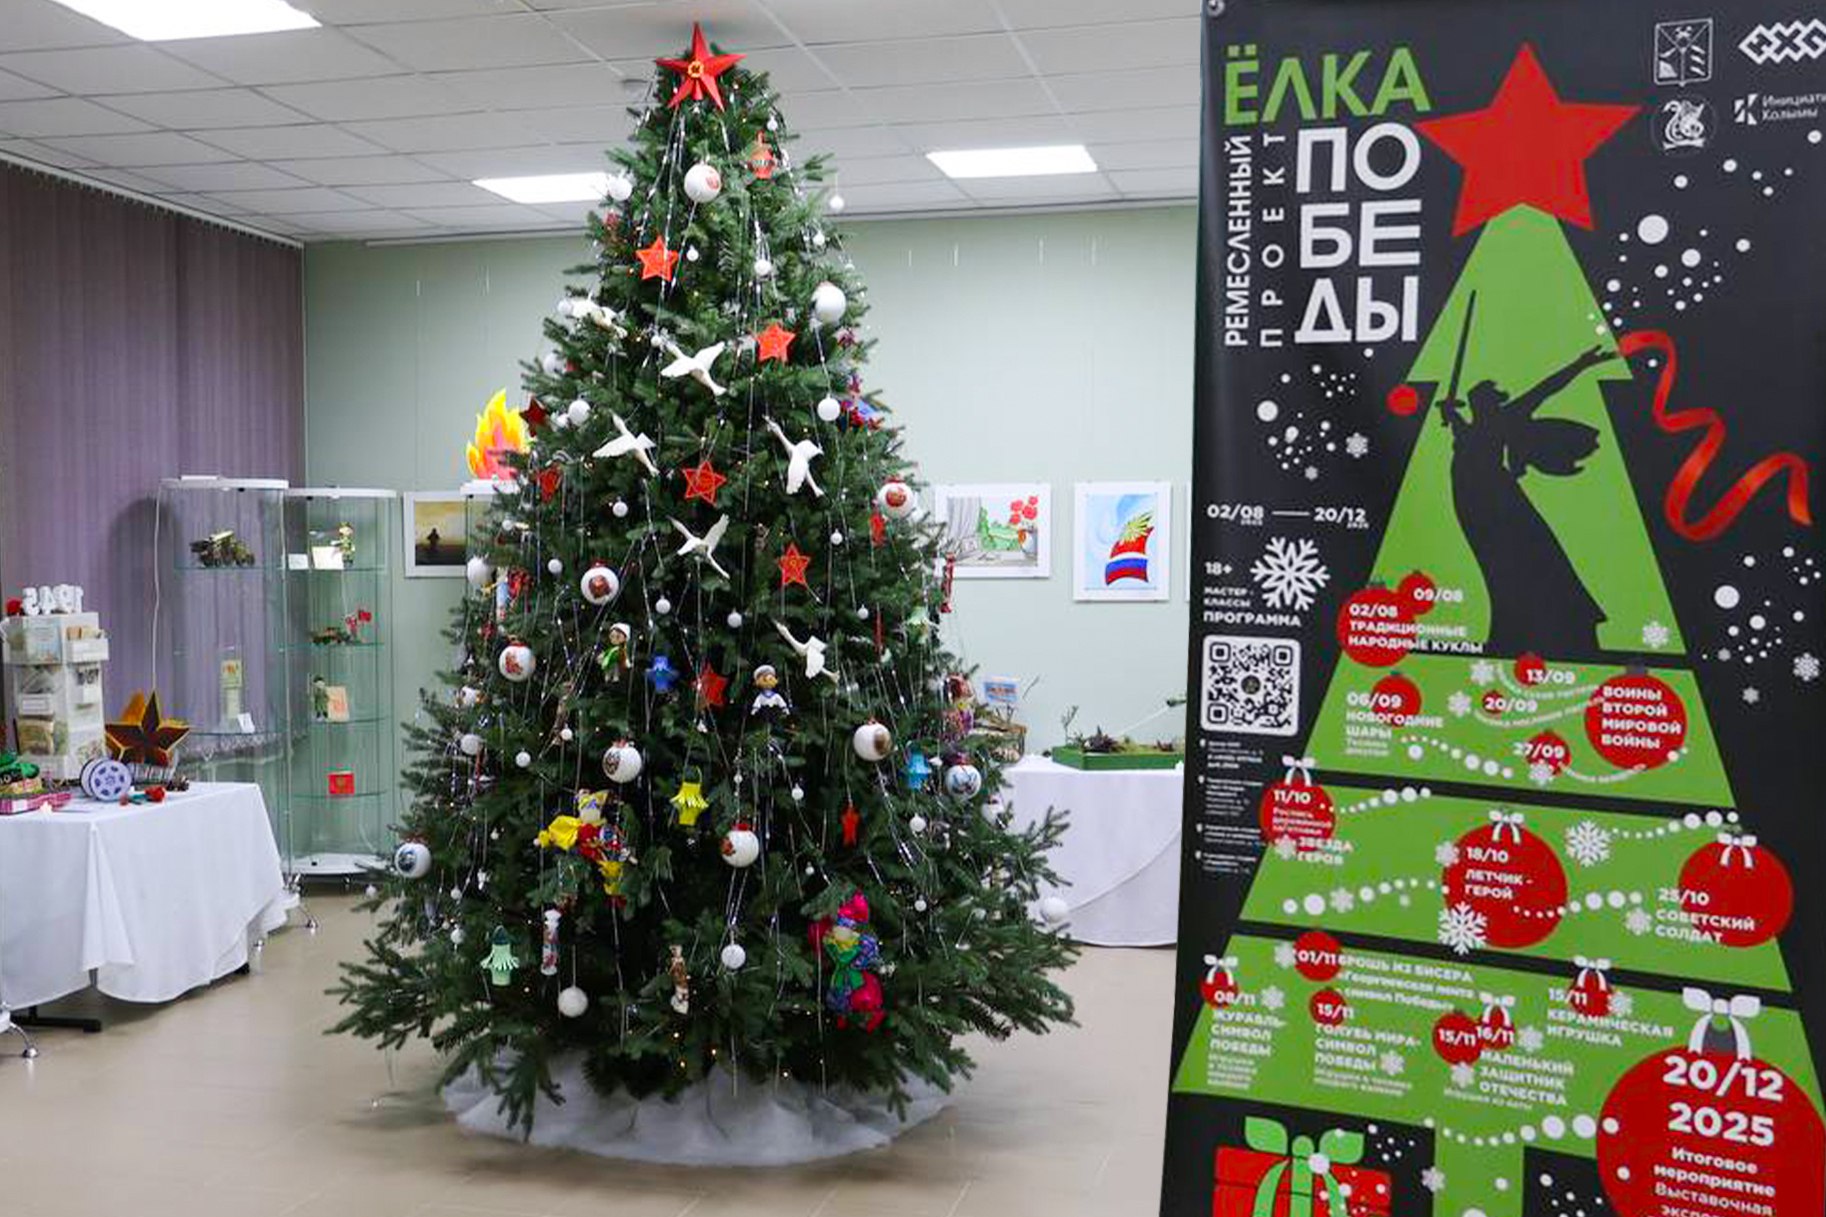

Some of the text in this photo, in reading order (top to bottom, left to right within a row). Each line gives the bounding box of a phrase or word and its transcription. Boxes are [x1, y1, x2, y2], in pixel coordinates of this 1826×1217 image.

[1224, 44, 1431, 124] ЁЛКА
[1296, 122, 1420, 193] ПО
[1225, 135, 1252, 346] РЕМЕСЛЕННЫЙ
[1260, 133, 1286, 347] ПРОЕКТ
[1299, 199, 1421, 268] БЕ
[1294, 275, 1419, 344] ДЫ
[1207, 503, 1366, 523] 02/08 20/12
[1204, 561, 1232, 575] 18+
[1203, 598, 1250, 608] КЛАССЫ
[1414, 587, 1463, 602] 09/08
[1203, 611, 1301, 627] ПРОГРАММА
[1350, 603, 1398, 618] 02/08
[1350, 621, 1467, 637] ТРАДИЦИОННЫЕ
[1348, 636, 1483, 654] НАРОДНЫЕ КУКЛЫ
[1526, 669, 1575, 684] 13/09
[1347, 692, 1402, 708] 06/09
[1602, 686, 1662, 701] ВОИНЫ
[1485, 697, 1538, 712] 20/09
[1602, 701, 1668, 717] ВТОРОЙ
[1346, 711, 1443, 728] НОВОГОДНИЕ
[1602, 717, 1682, 734] МИРОВОЙ
[1346, 725, 1392, 740] ШАРЫ
[1601, 733, 1661, 750] ВОЙНЫ
[1512, 742, 1565, 759] 27/09
[1273, 789, 1311, 805] 11/10
[1466, 846, 1508, 863] 18/10
[1465, 869, 1523, 886] ЛЕТЧИК
[1465, 884, 1513, 900] ГЕРОЙ
[1659, 888, 1710, 906] 25/10
[1656, 909, 1756, 931] СОВЕТСКИЙ
[1655, 924, 1723, 943] СОЛДАТ
[1298, 950, 1337, 965] 01/11
[1549, 987, 1588, 1005] 15/11
[1317, 1003, 1354, 1019] 15/11
[1210, 1023, 1271, 1041] СИМВОЛ
[1314, 1023, 1373, 1040] ГОЛУБЬ
[1547, 1009, 1675, 1038] КЕРАМИЧЕСКАЯ
[1439, 1025, 1515, 1047] 15/11 16/11
[1547, 1026, 1623, 1047] ИГРУШКА
[1210, 1038, 1271, 1057] ПОБЕДЫ
[1315, 1038, 1377, 1056] СИМВОЛ
[1315, 1052, 1377, 1070] ПОБЕДЫ
[1480, 1050, 1574, 1076] МАЛЕНЬКИЙ
[1479, 1065, 1566, 1090] ЗАЩИТНИК
[1663, 1055, 1783, 1102] 20/12
[1479, 1081, 1567, 1106] ОТЕЧЕСТВА
[1668, 1102, 1775, 1147] 2025
[1671, 1146, 1758, 1175] Итоговое
[1653, 1164, 1776, 1198] мероприятие
[1655, 1181, 1774, 1216] Выставочная
